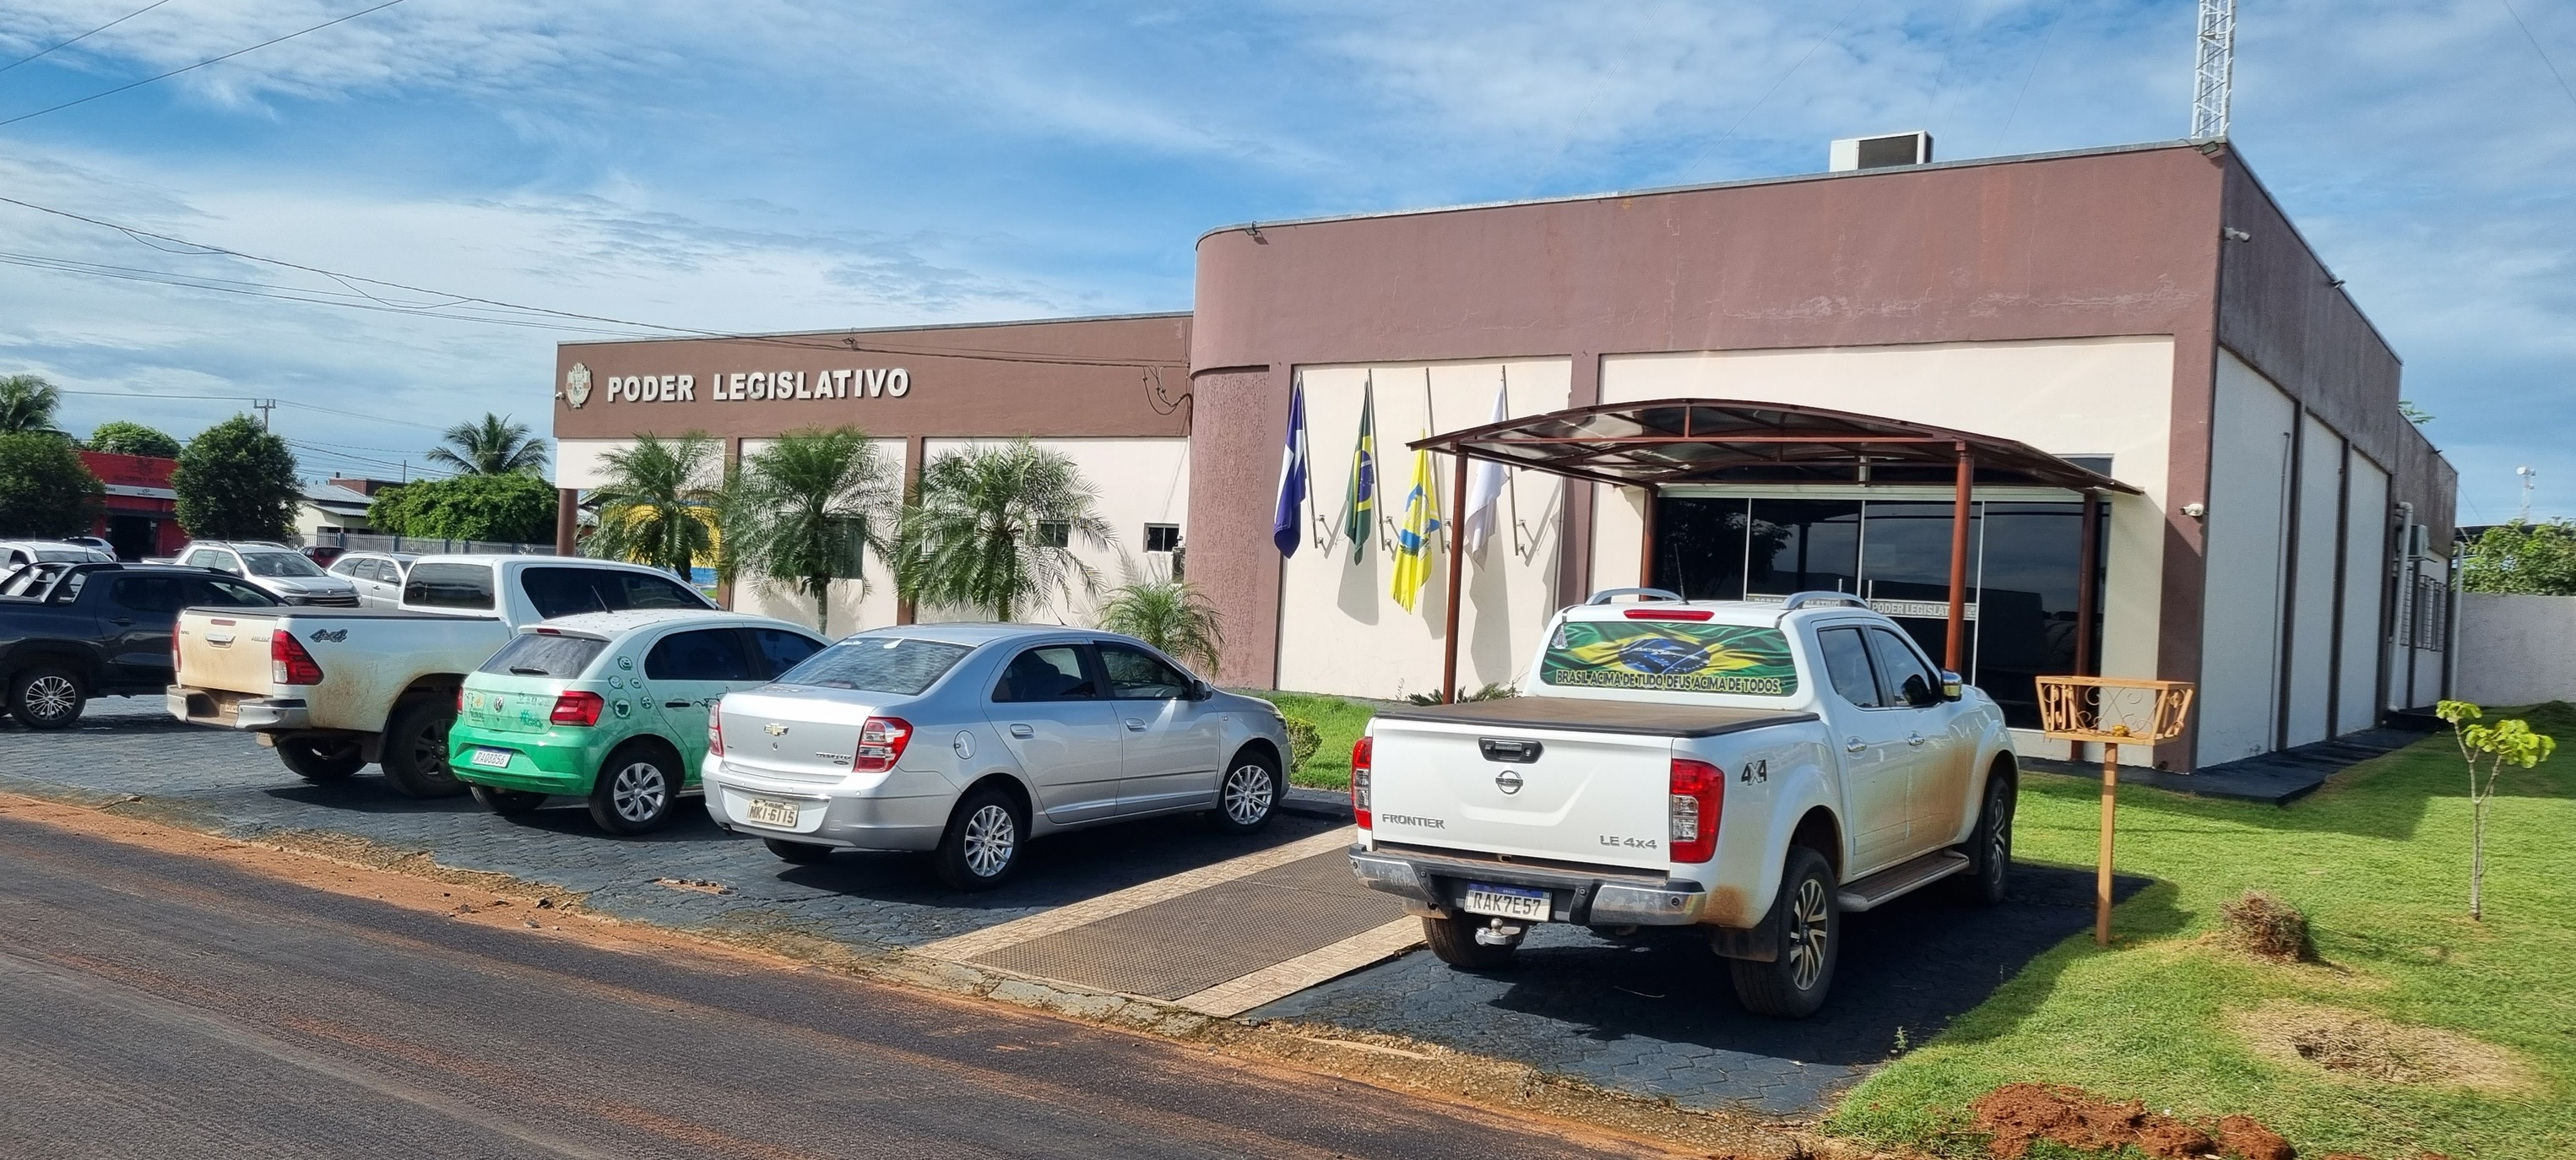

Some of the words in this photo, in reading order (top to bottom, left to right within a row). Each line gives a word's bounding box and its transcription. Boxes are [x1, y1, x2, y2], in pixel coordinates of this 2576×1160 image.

[607, 375, 695, 403] PODER
[713, 368, 909, 401] LEGISLATIVO
[1872, 603, 1903, 615] PODER
[1557, 669, 1588, 684] BRASIL
[1590, 671, 1622, 686] ACIMA
[1622, 673, 1635, 687] DE
[1667, 675, 1690, 690] DEUS
[1693, 675, 1727, 691] ACIMA
[1727, 677, 1740, 691] DE
[1382, 813, 1445, 830] FRONTIER
[1599, 834, 1619, 847] LE
[1473, 892, 1542, 916] RAK7E57
